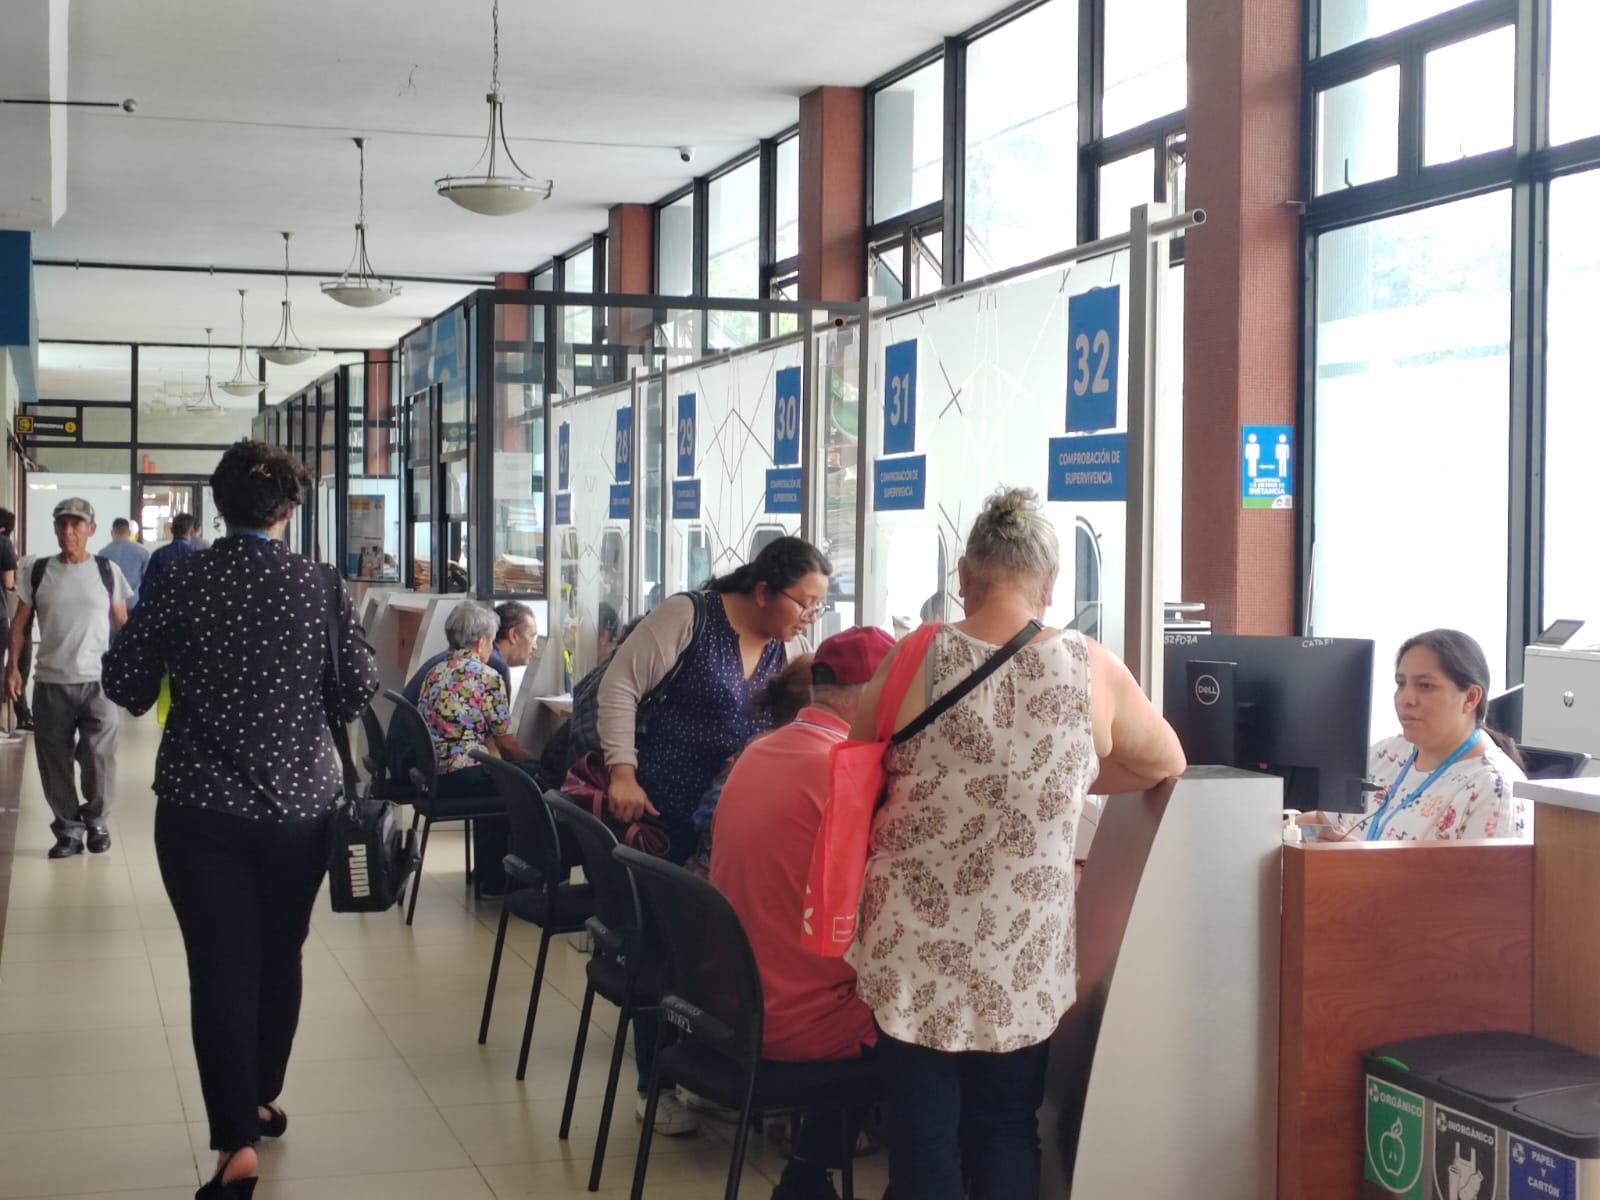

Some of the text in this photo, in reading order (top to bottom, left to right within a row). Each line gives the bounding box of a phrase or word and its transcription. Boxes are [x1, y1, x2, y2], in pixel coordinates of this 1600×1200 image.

[1073, 329, 1111, 396] 32
[890, 373, 910, 426] 31
[776, 395, 797, 441] 30
[616, 429, 628, 464] 28
[679, 417, 693, 456] 29
[559, 442, 568, 473] 27
[1059, 449, 1121, 466] COMPROBACIÓN DE
[1065, 470, 1113, 485] SUPERVIVENCIA
[1198, 684, 1217, 695] DELL
[347, 843, 370, 898] PUMA
[1380, 1090, 1422, 1118] ORGÁNICO
[1447, 1120, 1495, 1146] INORGÁNICO
[1531, 1150, 1556, 1169] PAPEL
[1540, 1167, 1547, 1177] Y
[1527, 1176, 1560, 1198] CARTÓN
